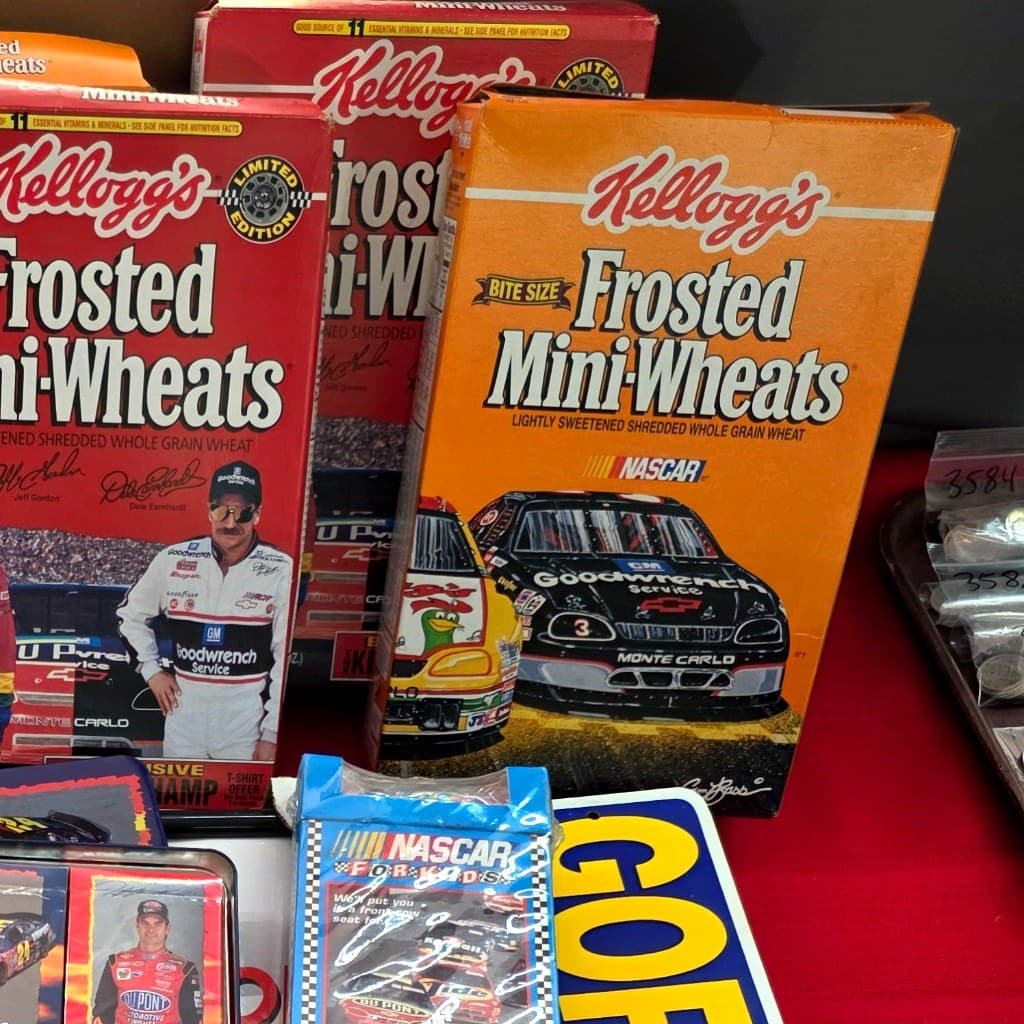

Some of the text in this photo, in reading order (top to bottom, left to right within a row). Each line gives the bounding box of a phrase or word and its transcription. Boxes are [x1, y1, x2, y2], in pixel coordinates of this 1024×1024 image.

[558, 61, 621, 89] LIMITED
[232, 157, 299, 190] LIMITED
[586, 152, 826, 249] Kellogg's
[230, 210, 297, 242] EDITION
[488, 278, 563, 304] BITE SIZE
[572, 247, 805, 340] Frosted
[485, 328, 850, 423] Mini-Wheats
[511, 414, 805, 442] LIGHTLY SWEETENED SHREDDED WHOLE GRAIN WHEAT
[38, 432, 107, 449] SHREDDED
[110, 434, 158, 450] WHOLE
[161, 436, 203, 452] GRAIN
[205, 438, 254, 454] WHEAT
[619, 456, 703, 483] NASCAR
[943, 463, 1019, 499] 3584
[532, 570, 770, 595] Goodwrench
[627, 583, 704, 596] Service
[575, 618, 591, 638] 3
[191, 663, 231, 676] Service
[616, 651, 737, 666] MONTE CARLO
[73, 717, 130, 728] CARLO
[386, 832, 513, 869] NASCAR
[367, 896, 415, 909] put you
[332, 915, 361, 925] seat
